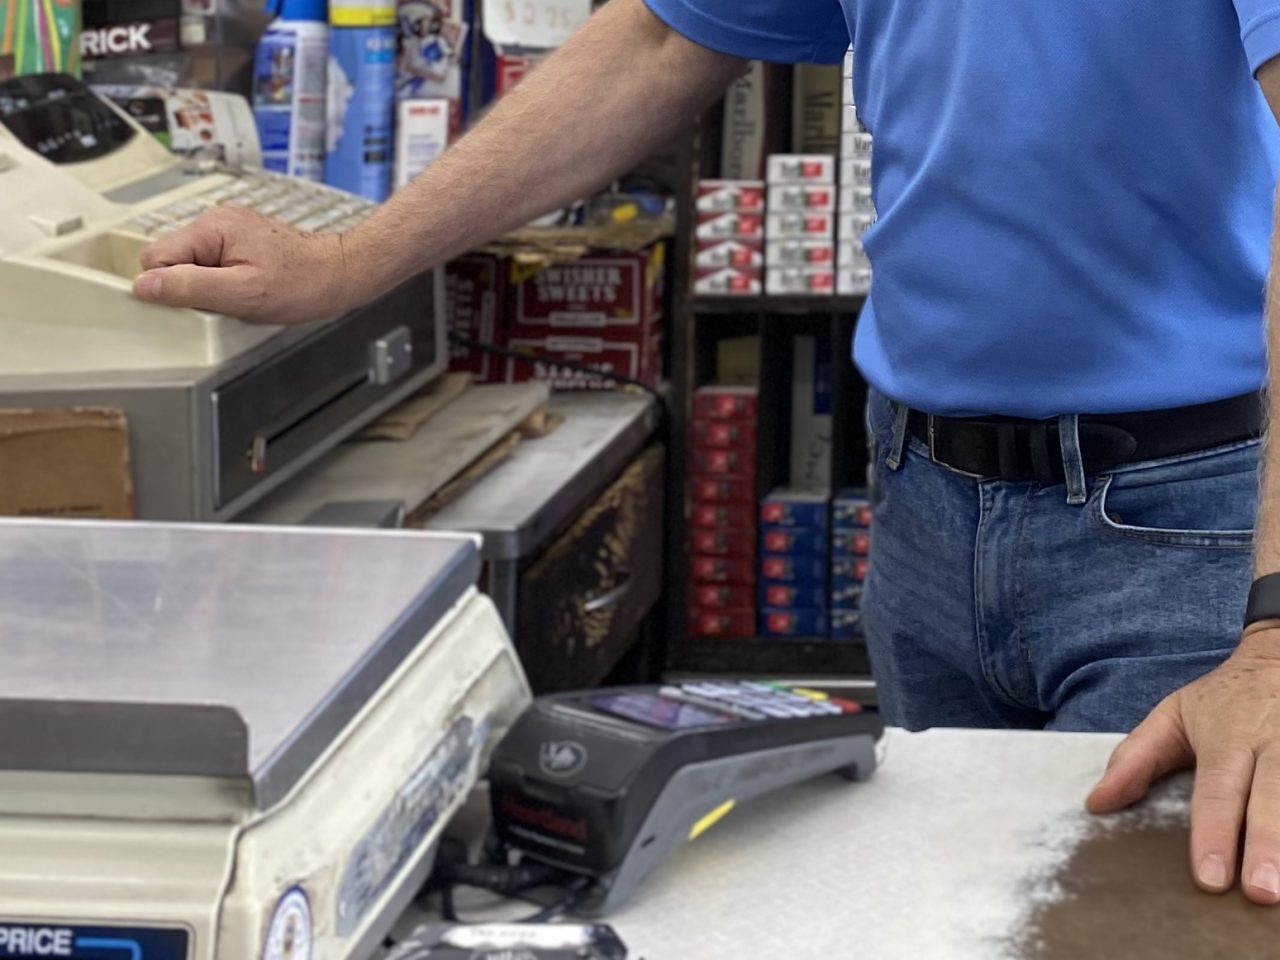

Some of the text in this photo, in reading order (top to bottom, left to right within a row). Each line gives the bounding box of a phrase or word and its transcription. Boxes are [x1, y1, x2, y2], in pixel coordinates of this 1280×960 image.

[534, 266, 623, 286] SWISHER
[537, 286, 618, 303] SWEETS
[0, 926, 73, 955] PRICE
